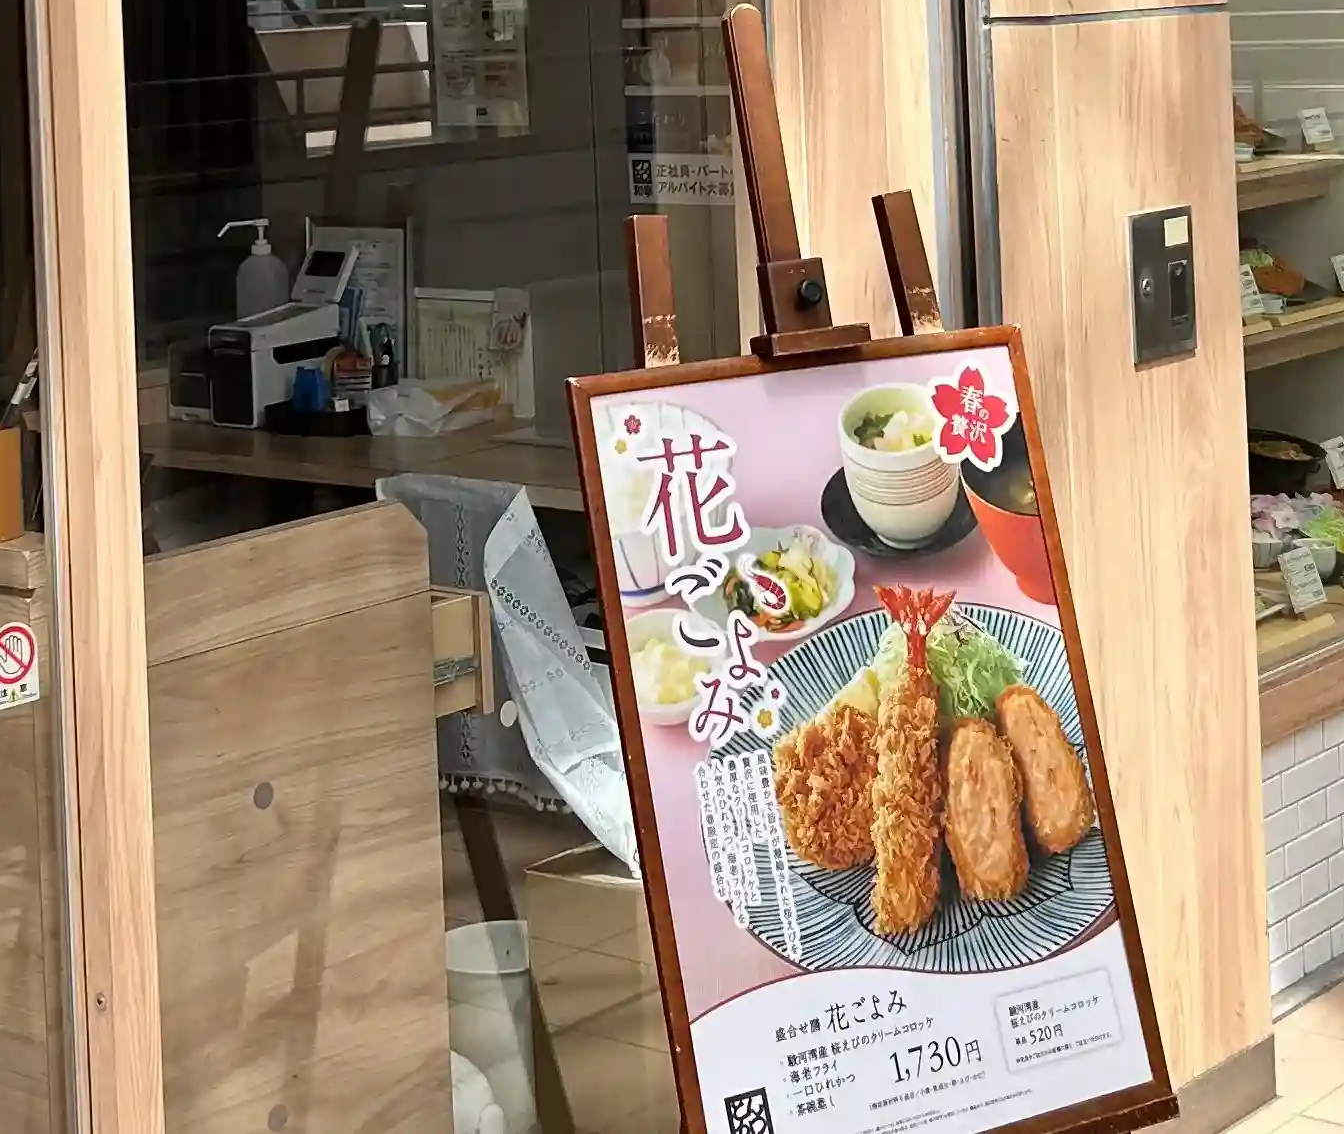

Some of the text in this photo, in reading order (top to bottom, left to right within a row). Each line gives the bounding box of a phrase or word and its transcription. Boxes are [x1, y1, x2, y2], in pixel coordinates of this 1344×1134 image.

[636, 435, 761, 739] 花ごよみ
[825, 989, 907, 1034] 花ごよみ
